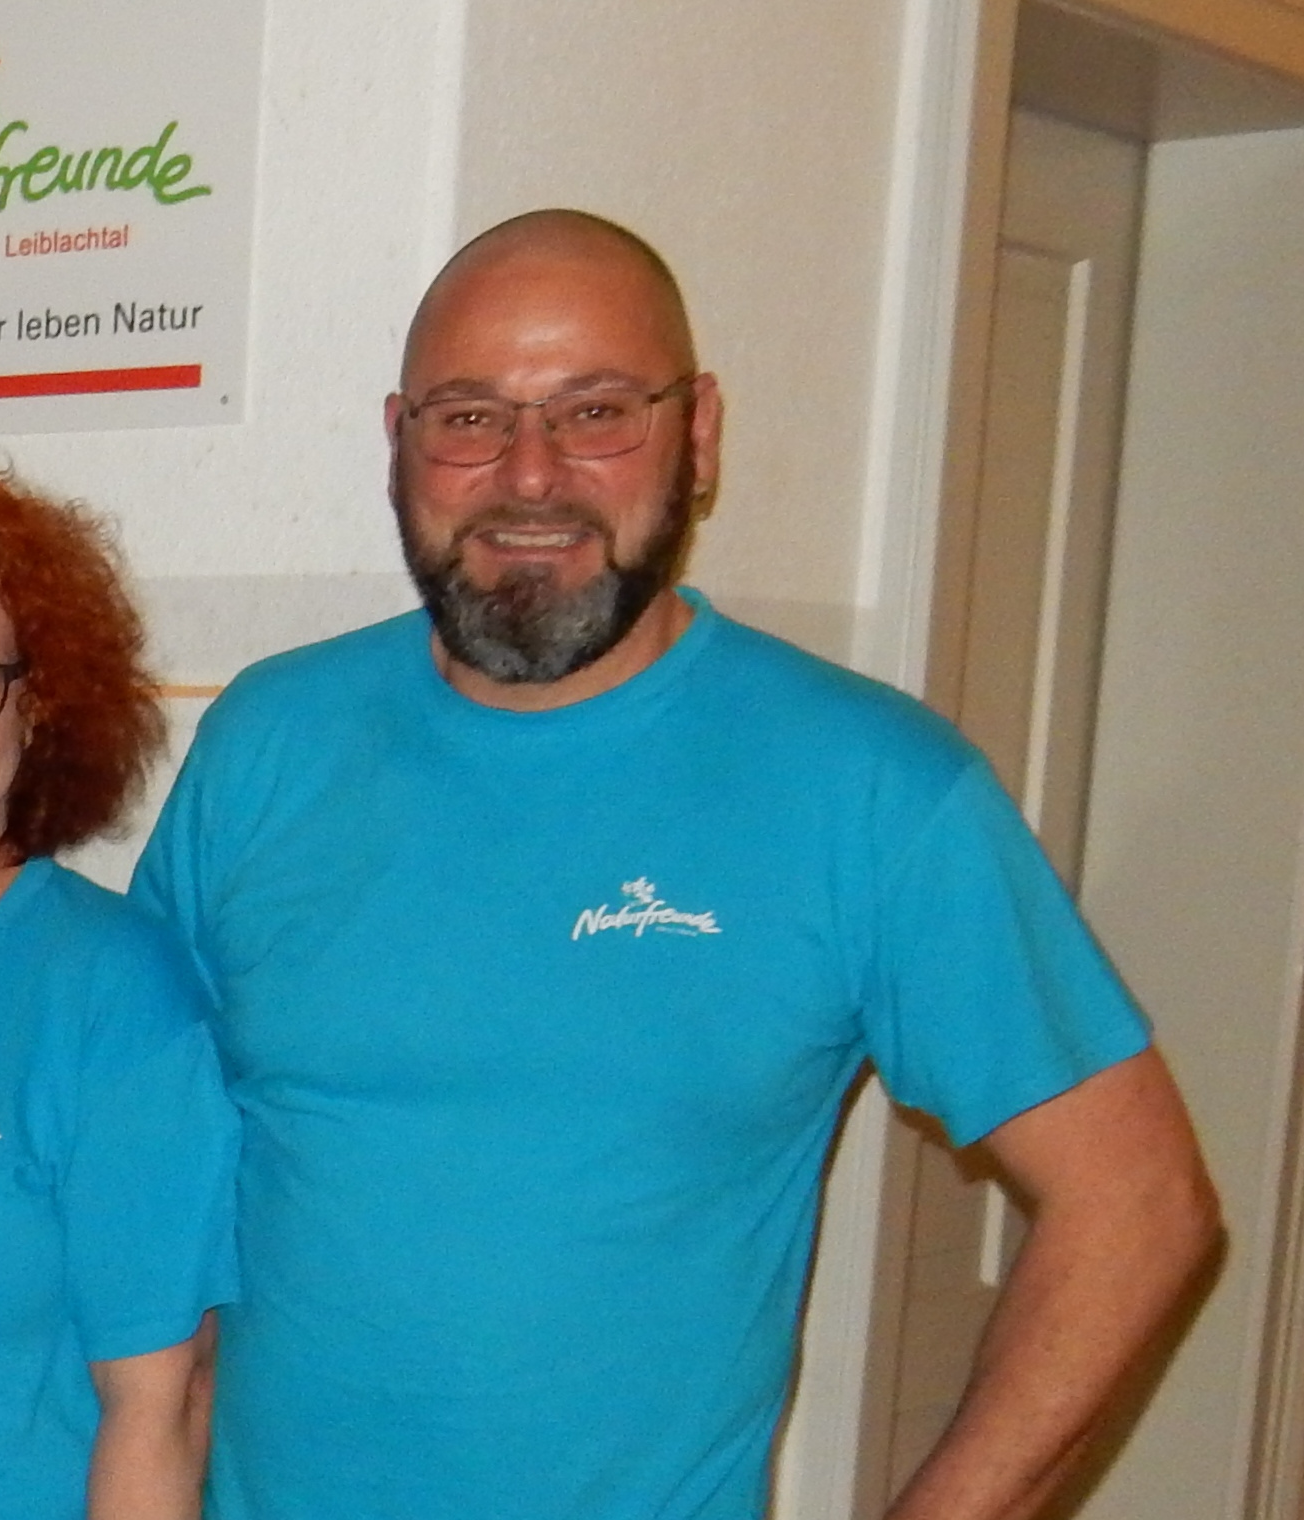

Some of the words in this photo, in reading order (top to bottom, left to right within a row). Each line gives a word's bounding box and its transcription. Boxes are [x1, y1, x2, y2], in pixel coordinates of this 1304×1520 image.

[4, 224, 130, 258] Leiblachtal
[17, 308, 101, 341] leben
[113, 302, 203, 334] Natur
